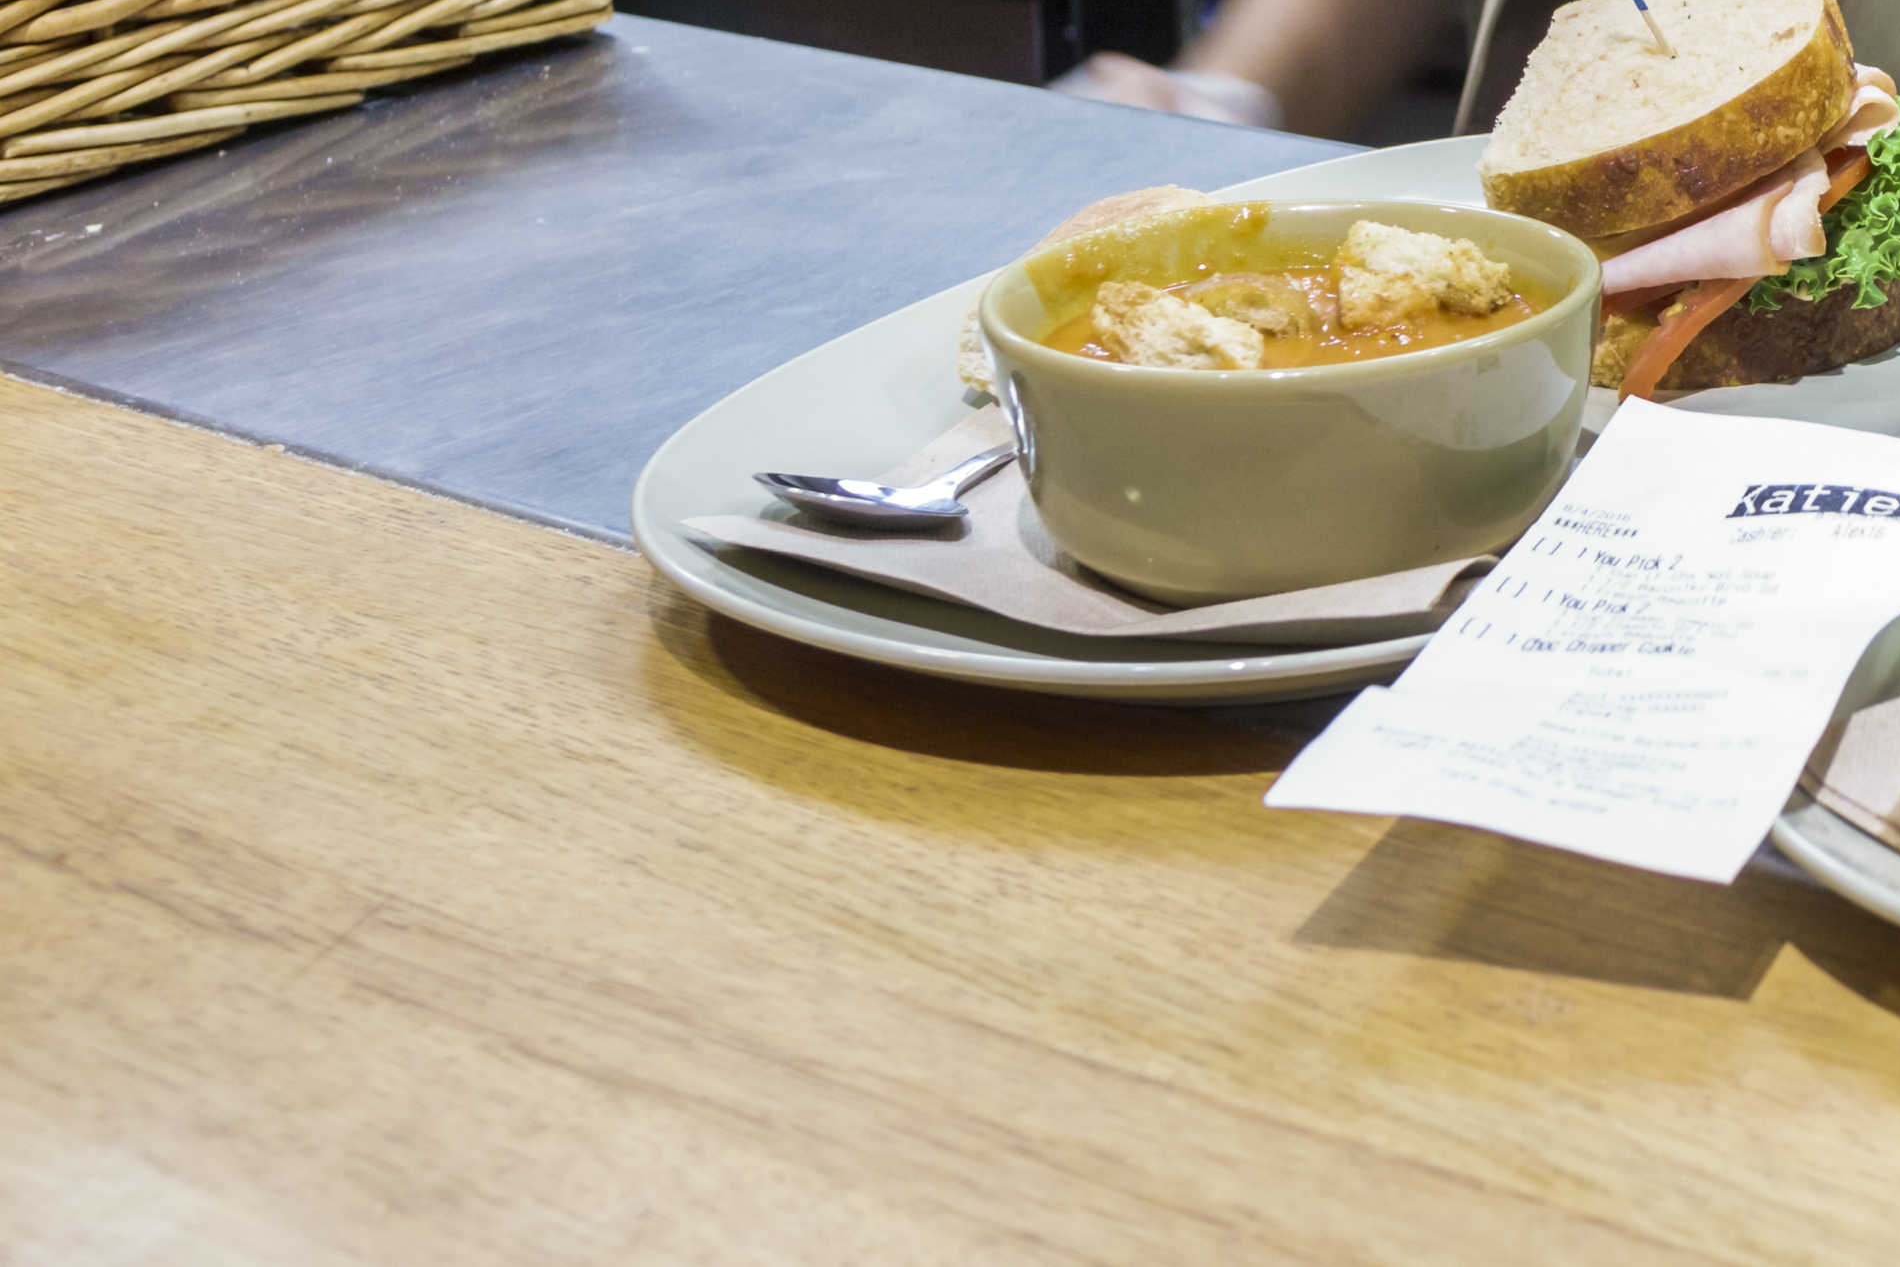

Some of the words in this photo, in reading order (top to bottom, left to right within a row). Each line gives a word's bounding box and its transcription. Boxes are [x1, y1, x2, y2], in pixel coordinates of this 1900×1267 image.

[1742, 484, 1900, 516] Katie
[1594, 550, 1621, 567] You
[1625, 554, 1663, 571] Pick
[1668, 554, 1683, 571] 2
[1559, 593, 1588, 610] You
[1591, 599, 1629, 613] Pick
